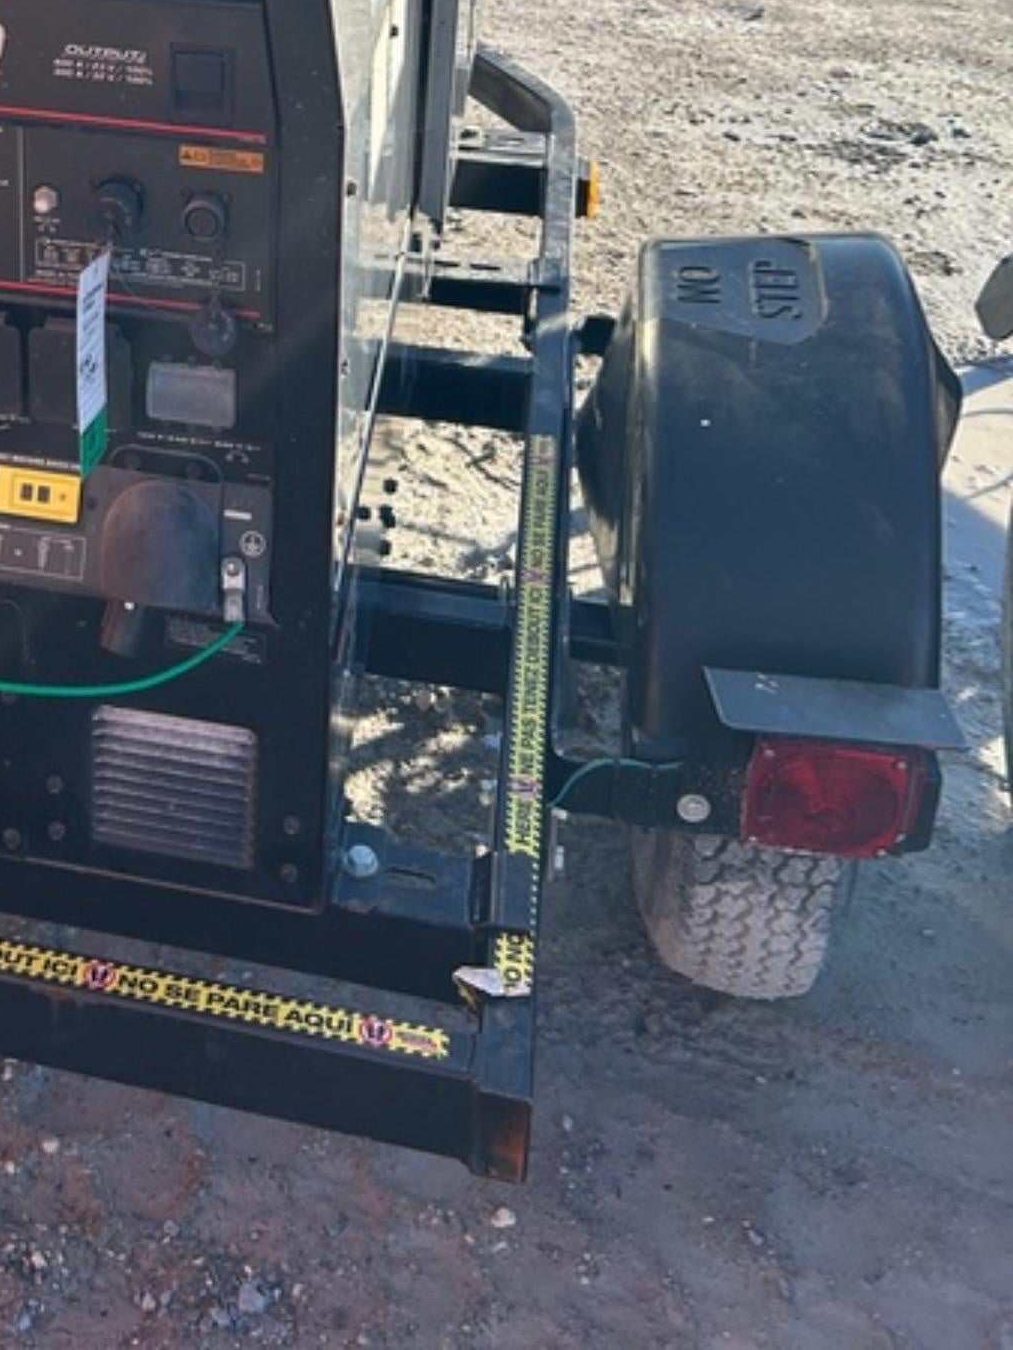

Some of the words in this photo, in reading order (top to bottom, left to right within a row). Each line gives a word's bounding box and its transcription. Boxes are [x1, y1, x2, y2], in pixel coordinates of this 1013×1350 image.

[41, 955, 80, 978] ICI
[118, 973, 159, 994] NO
[165, 982, 202, 1002] SE
[205, 990, 279, 1018] PARE
